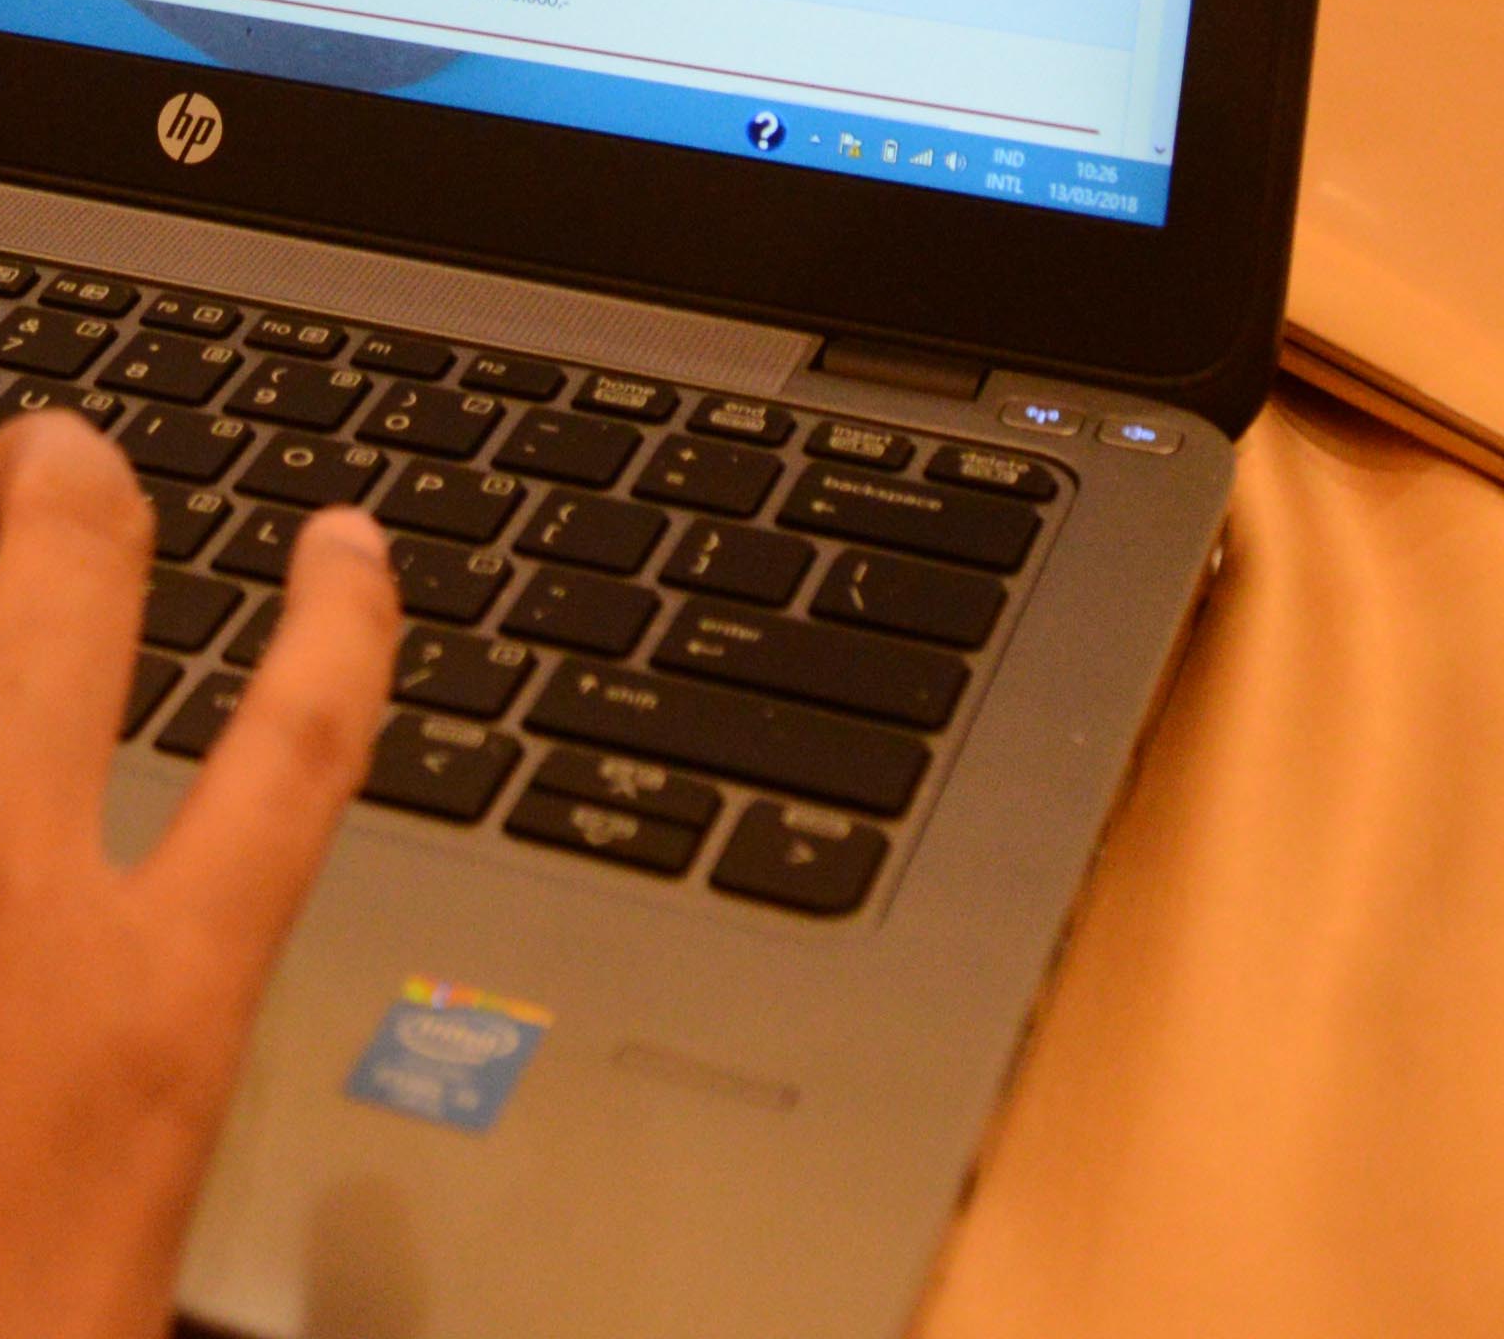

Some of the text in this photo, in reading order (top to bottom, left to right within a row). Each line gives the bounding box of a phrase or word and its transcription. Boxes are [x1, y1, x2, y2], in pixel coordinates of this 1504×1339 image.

[158, 92, 223, 164] hp
[994, 148, 1025, 168] IND
[1075, 161, 1118, 183] 10:26
[985, 173, 1023, 194] INTL
[2, 336, 24, 352] 7
[126, 364, 149, 379] 8
[20, 390, 49, 409] U
[253, 388, 278, 405] 9
[282, 447, 314, 468] O
[415, 474, 445, 492] P
[257, 521, 279, 544] L
